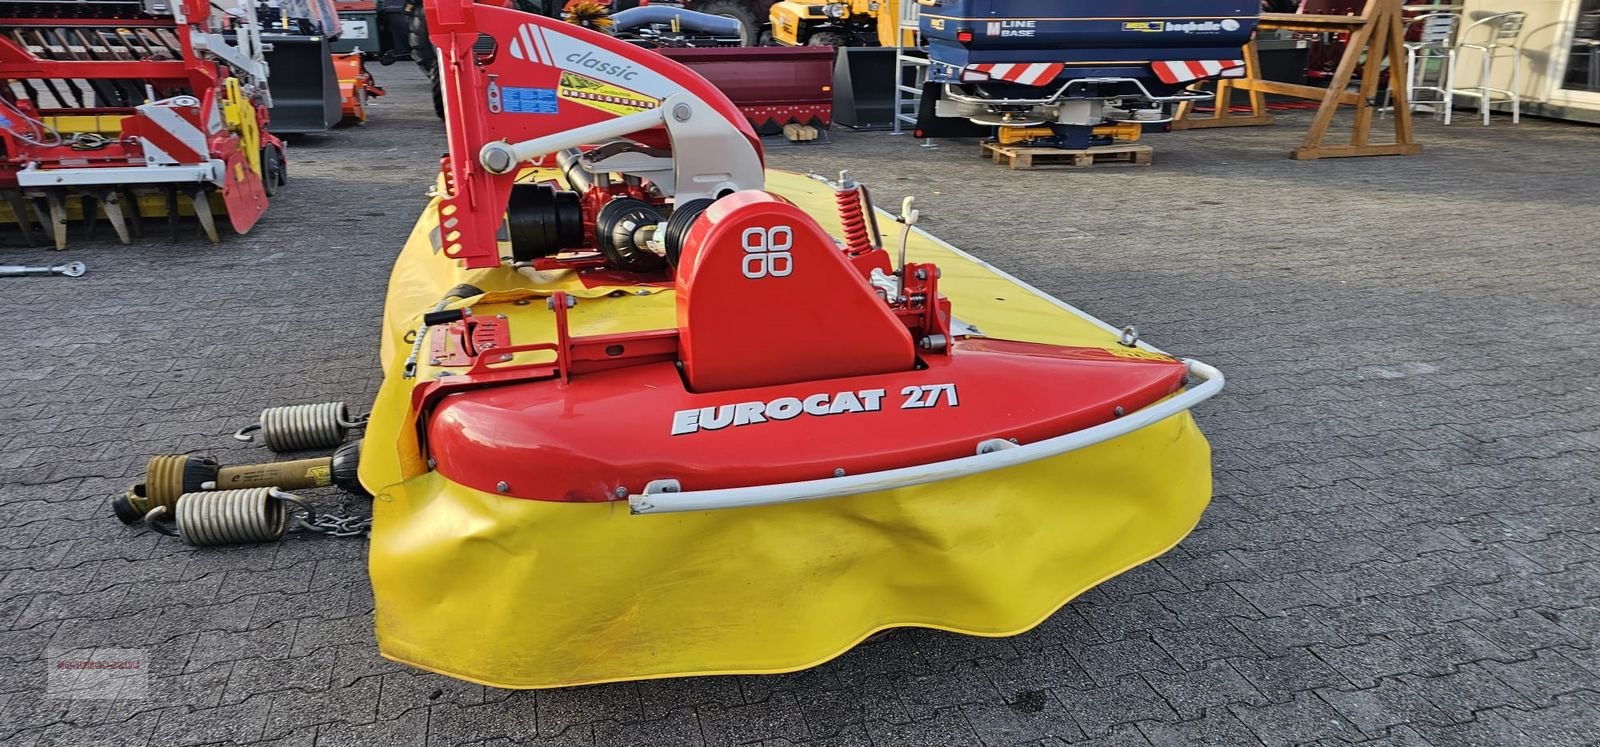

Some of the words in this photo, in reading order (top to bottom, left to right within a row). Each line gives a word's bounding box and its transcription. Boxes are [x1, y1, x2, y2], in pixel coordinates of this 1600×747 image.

[987, 22, 1001, 36] M
[1002, 20, 1036, 28] LINE
[565, 51, 638, 80] classic
[562, 88, 655, 109] AMSELGRUBER
[671, 388, 886, 436] EUROCAT
[900, 383, 959, 410] 271
